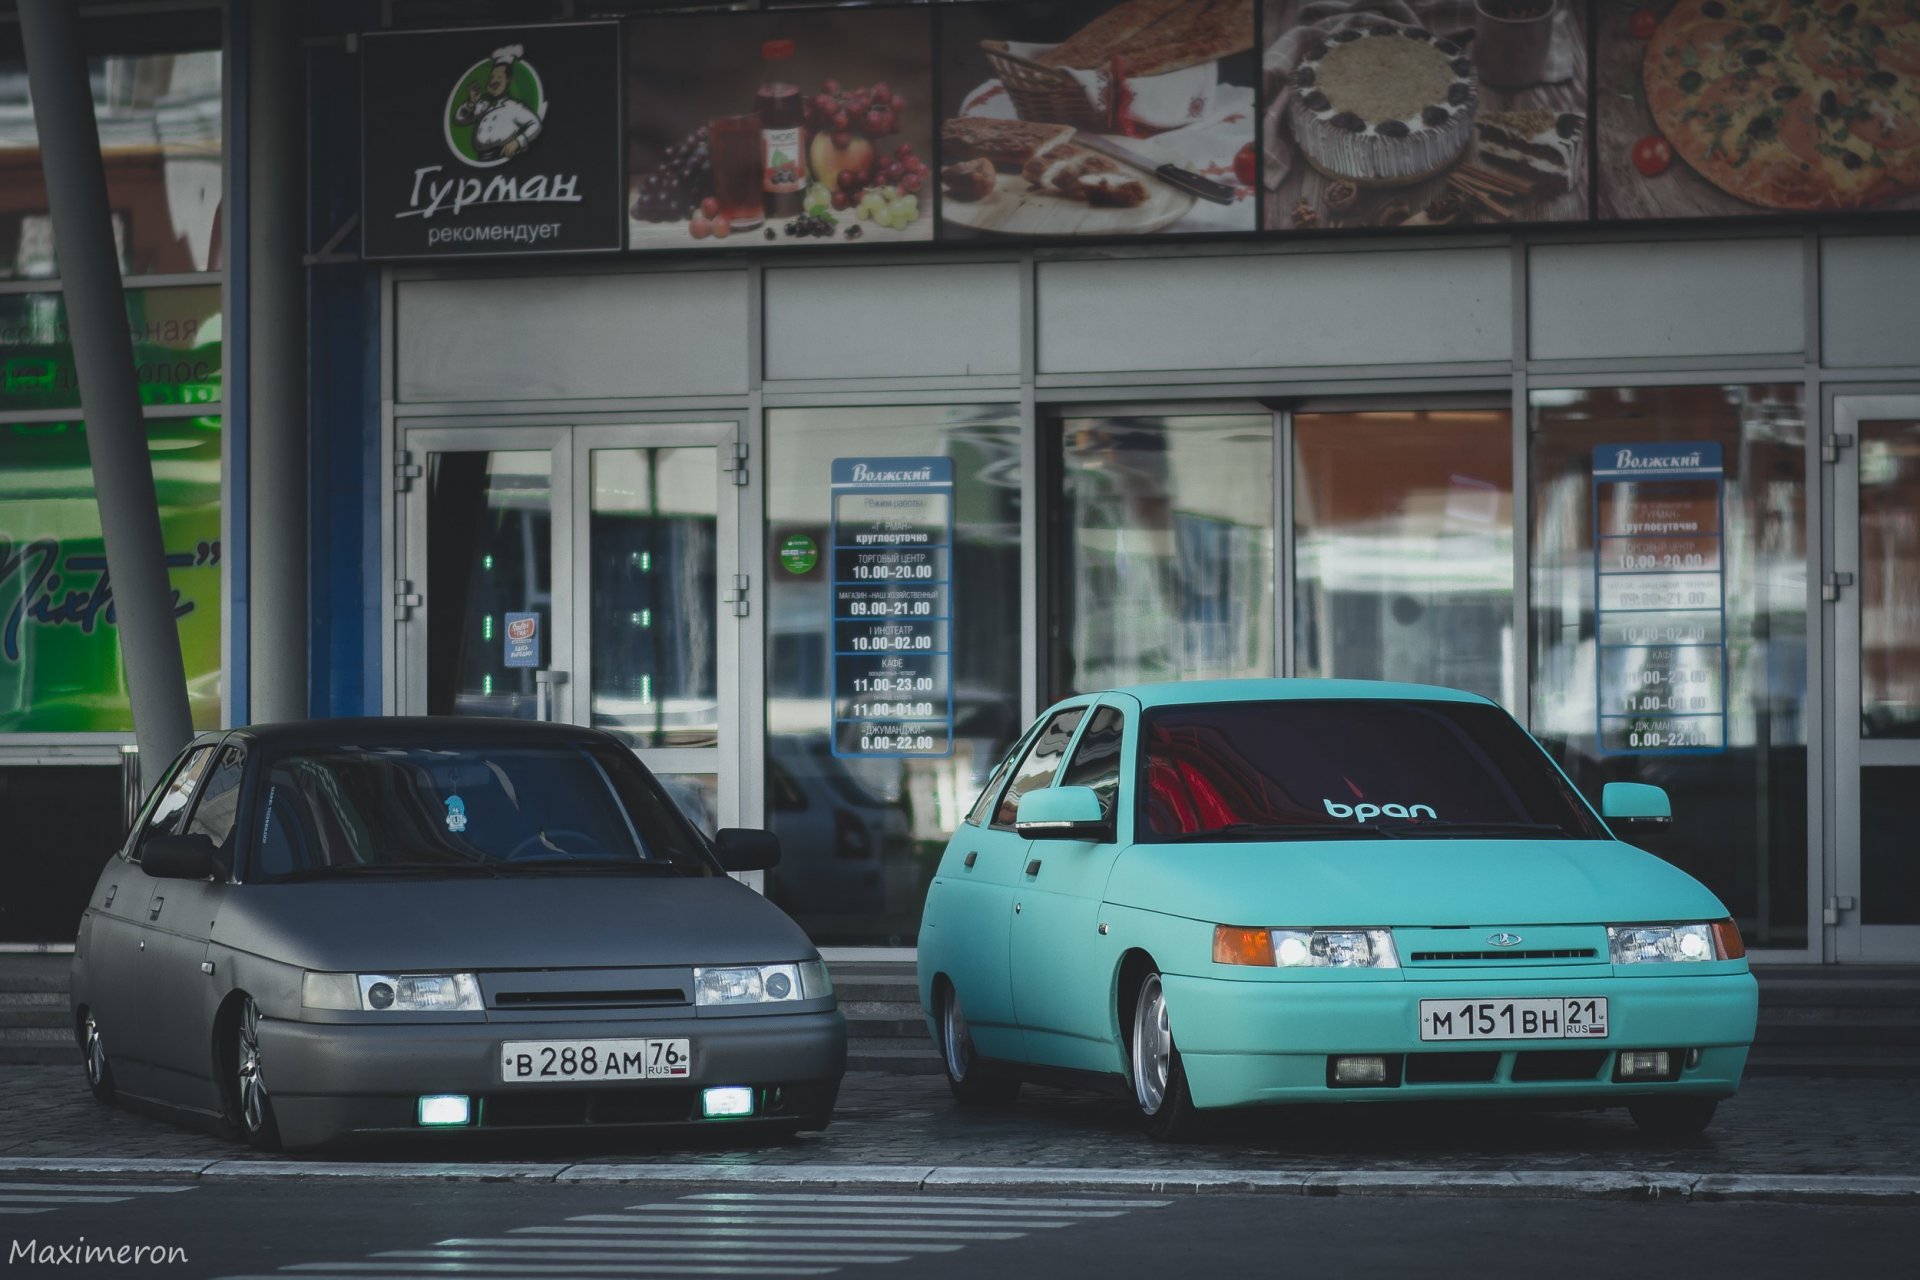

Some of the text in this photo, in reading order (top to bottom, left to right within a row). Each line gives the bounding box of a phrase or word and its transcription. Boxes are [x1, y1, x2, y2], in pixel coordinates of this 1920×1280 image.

[398, 164, 582, 219] Гурман
[428, 221, 561, 246] рекомендует
[1615, 449, 1702, 469] Волжский
[852, 463, 933, 482] Волжский
[856, 533, 928, 545] круглосуточно
[858, 553, 926, 564] ТОРГОВЫЙ ЦЕНТР
[852, 565, 932, 579] 10.00-20.00
[851, 601, 930, 615] 09.00-21.00
[852, 636, 931, 651] 10.00-02.00
[881, 659, 904, 668] КАФЕ
[853, 678, 933, 692] 11.00-23.00
[853, 703, 933, 717] 11.00-01.00
[1567, 1000, 1596, 1024] 21
[1567, 1025, 1588, 1034] RUS
[650, 1042, 679, 1066] 76
[648, 1066, 670, 1075] RUS
